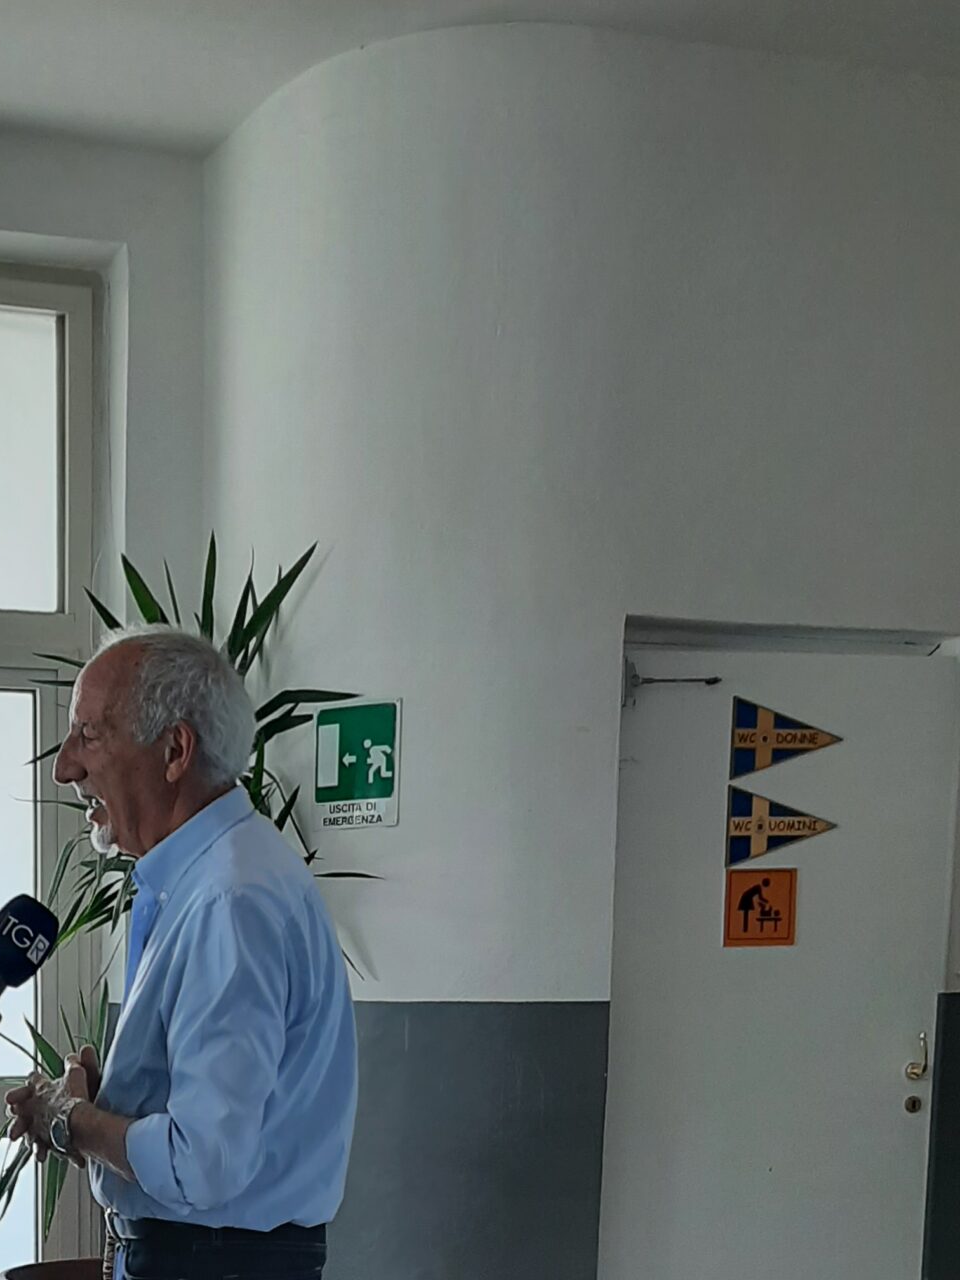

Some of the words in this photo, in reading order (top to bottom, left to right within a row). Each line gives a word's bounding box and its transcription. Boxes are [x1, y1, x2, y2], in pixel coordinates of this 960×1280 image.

[738, 732, 757, 744] WC
[776, 732, 819, 745] DONNE
[329, 803, 361, 814] USCITA
[366, 802, 377, 811] DI
[323, 814, 382, 826] EMERGENZA
[732, 820, 752, 833] WC
[768, 819, 818, 833] UOMINI
[1, 915, 50, 965] TGR
